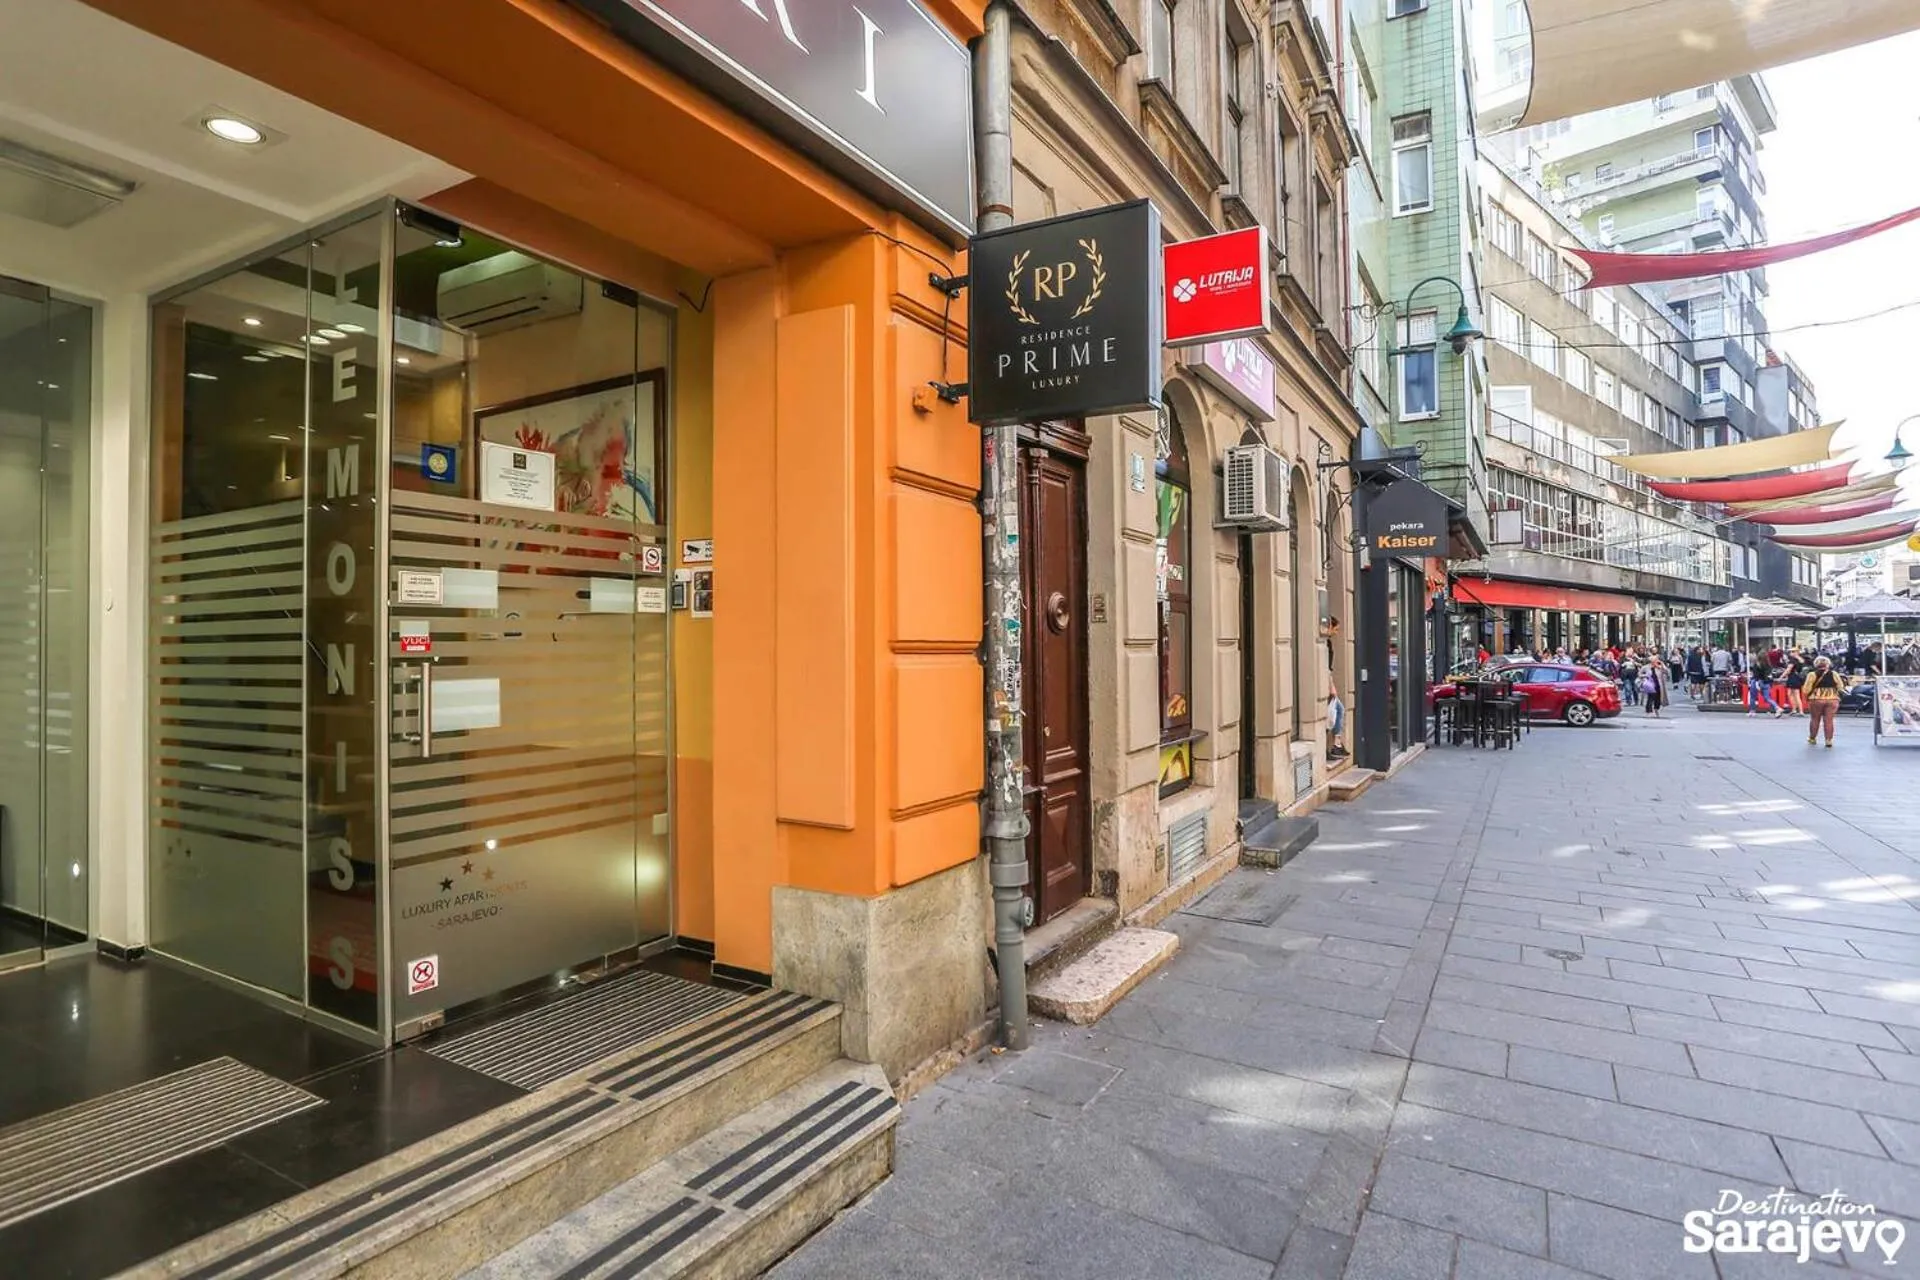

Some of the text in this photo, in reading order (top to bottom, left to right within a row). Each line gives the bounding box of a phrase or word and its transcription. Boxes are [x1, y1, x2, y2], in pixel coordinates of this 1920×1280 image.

[741, 0, 887, 117] I
[1034, 261, 1077, 302] RP
[1199, 266, 1254, 289] LUTRIJA
[1020, 326, 1091, 345] RESIDENCE
[997, 337, 1117, 378] PRIME
[1031, 374, 1081, 390] LUXURY
[1389, 522, 1425, 532] pekara
[1377, 534, 1437, 549] Kaiser
[401, 898, 451, 920] LUXURY
